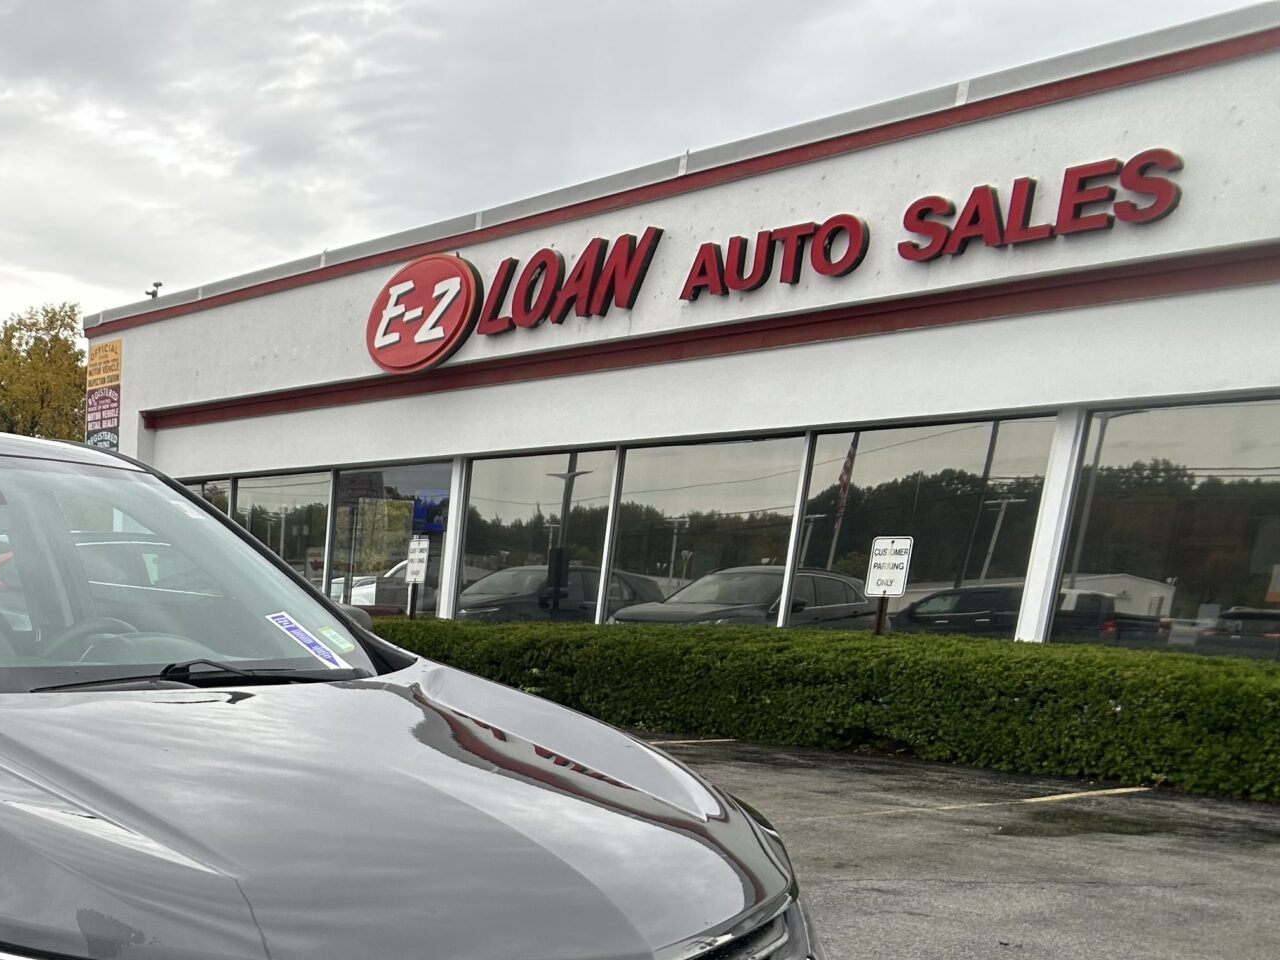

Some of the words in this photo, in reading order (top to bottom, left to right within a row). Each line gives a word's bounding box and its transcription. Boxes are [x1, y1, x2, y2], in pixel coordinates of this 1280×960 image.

[374, 276, 462, 349] E-Z
[477, 226, 665, 336] LOAN
[678, 213, 870, 301] AUTO
[897, 147, 1185, 263] SALES
[90, 343, 119, 361] OFFICIAL
[88, 387, 119, 406] REGISTERED
[102, 408, 119, 418] VEHICLE
[102, 417, 118, 428] DEALER
[87, 431, 118, 446] REGISTERED
[874, 548, 909, 556] CUSOMER
[876, 578, 894, 587] ONLY
